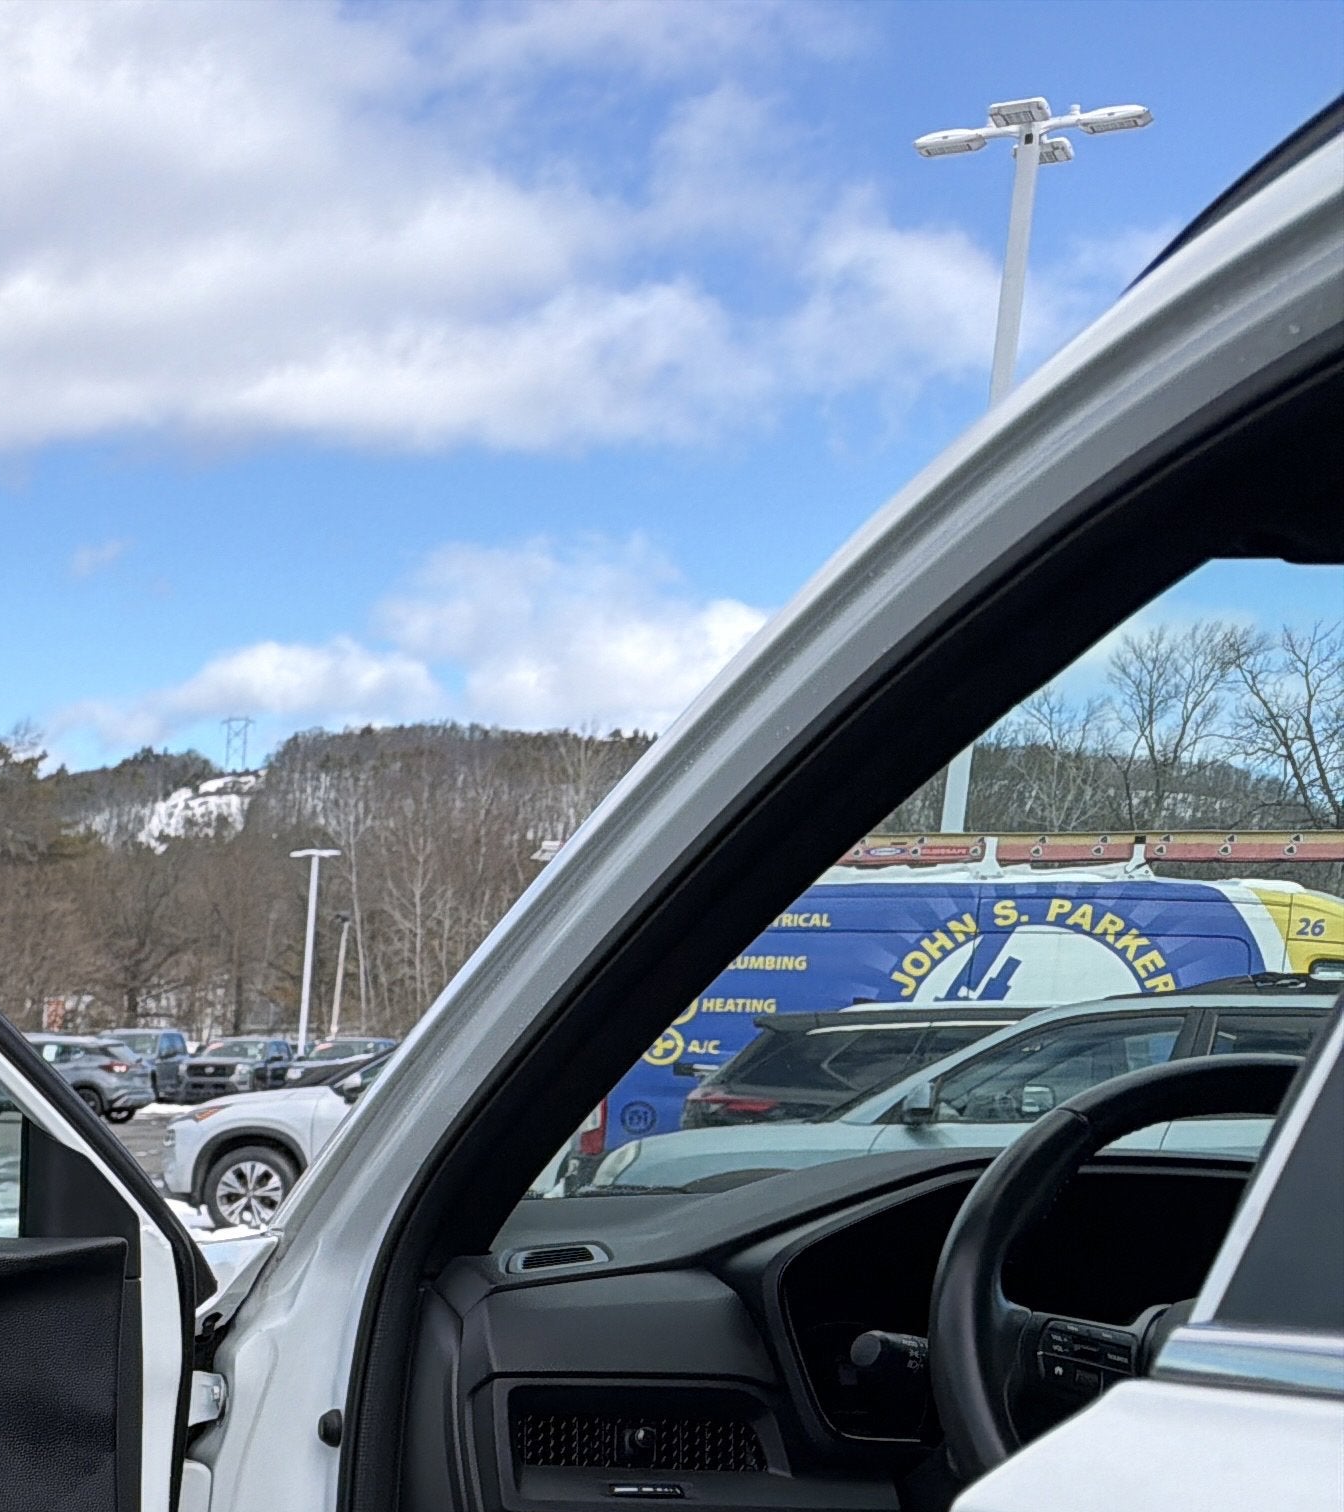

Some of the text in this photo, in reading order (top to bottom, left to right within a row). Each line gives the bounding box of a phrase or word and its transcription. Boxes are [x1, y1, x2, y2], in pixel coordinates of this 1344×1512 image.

[1296, 917, 1326, 937] 26
[890, 898, 1177, 998] JOHN S. PARKER
[702, 997, 777, 1014] HEATING
[687, 1039, 721, 1055] A/C
